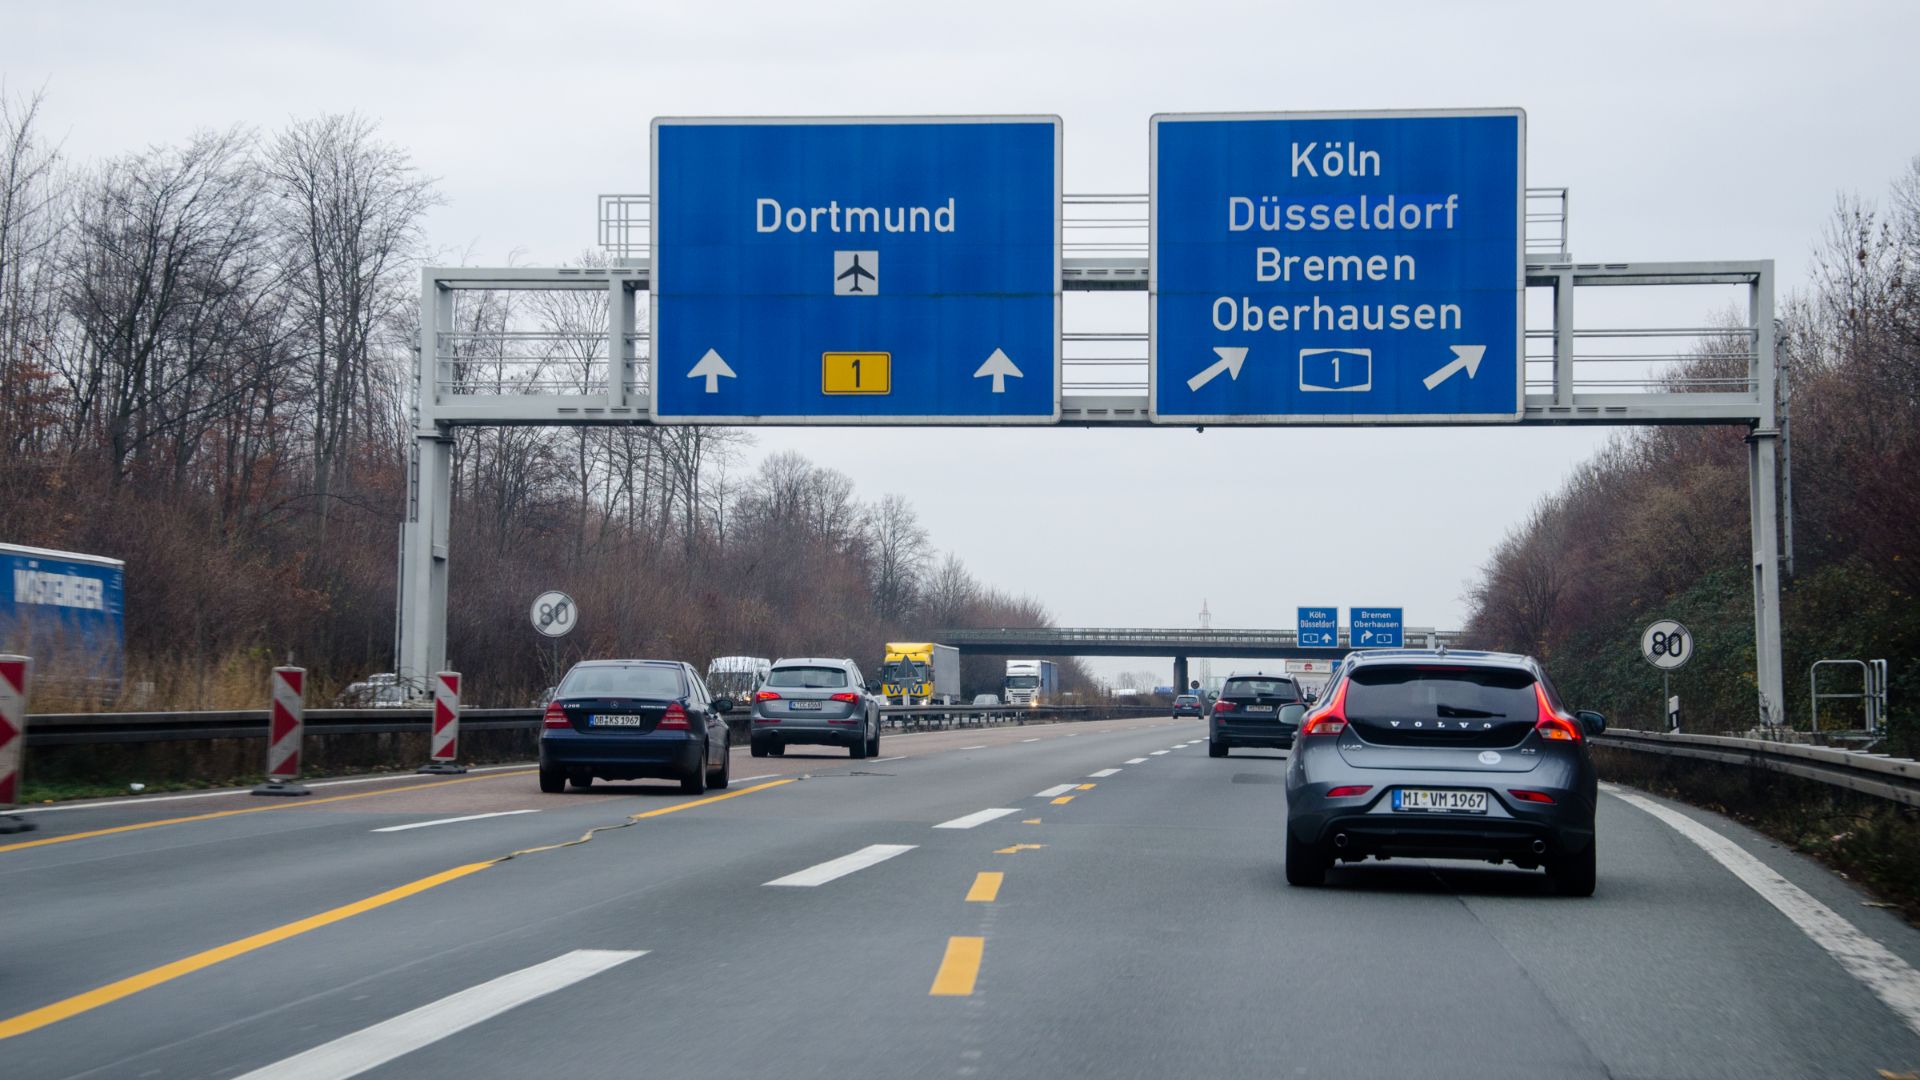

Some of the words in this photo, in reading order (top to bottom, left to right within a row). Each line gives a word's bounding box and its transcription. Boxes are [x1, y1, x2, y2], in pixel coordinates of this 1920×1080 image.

[1291, 141, 1381, 178] Köln
[756, 198, 955, 233] Dortmund
[1228, 194, 1459, 231] Düsseldorf
[1256, 247, 1416, 282] Bremen
[1212, 296, 1462, 331] Oberhausen
[851, 359, 860, 388] 1
[1331, 358, 1340, 383] 1
[539, 603, 569, 625] 80
[1300, 620, 1335, 629] Düsseldorf
[1309, 611, 1326, 619] Köln
[1354, 620, 1399, 628] Oberhausen
[1361, 611, 1391, 619] Bremen
[1652, 631, 1682, 657] 80
[610, 715, 619, 725] KS
[621, 715, 639, 725] 1967
[1390, 720, 1492, 729] VOLVO
[1403, 792, 1419, 806] MI
[1430, 792, 1448, 807] VM
[1450, 793, 1485, 808] 1967
